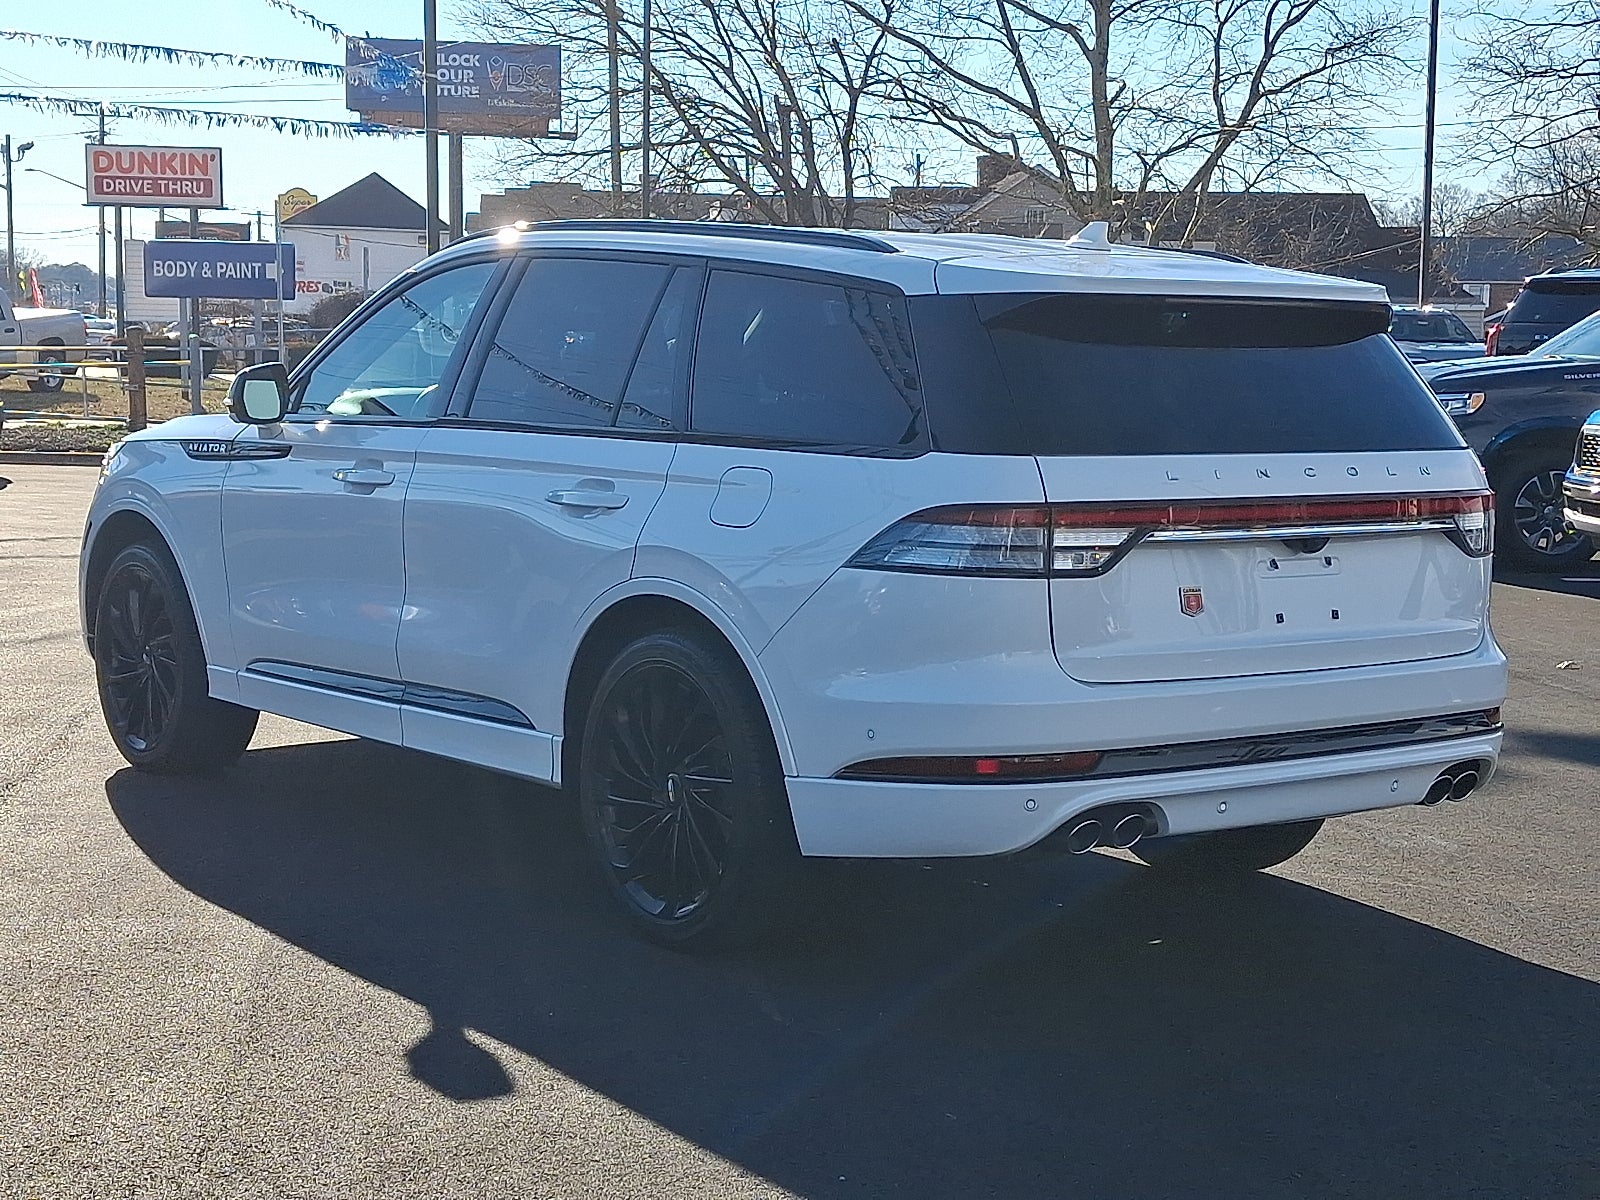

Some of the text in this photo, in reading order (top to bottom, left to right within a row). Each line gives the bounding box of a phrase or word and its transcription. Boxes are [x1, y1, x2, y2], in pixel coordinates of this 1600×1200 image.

[418, 52, 480, 66] ULOCK
[437, 68, 474, 82] OUR
[507, 63, 552, 87] DSC
[422, 84, 480, 98] TURE
[92, 150, 216, 176] DUNKIN'
[103, 178, 204, 195] DRIVE THRU
[153, 260, 262, 279] BODY & PAINT
[190, 444, 226, 454] AVIATOR
[1166, 466, 1430, 482] LINCOLN
